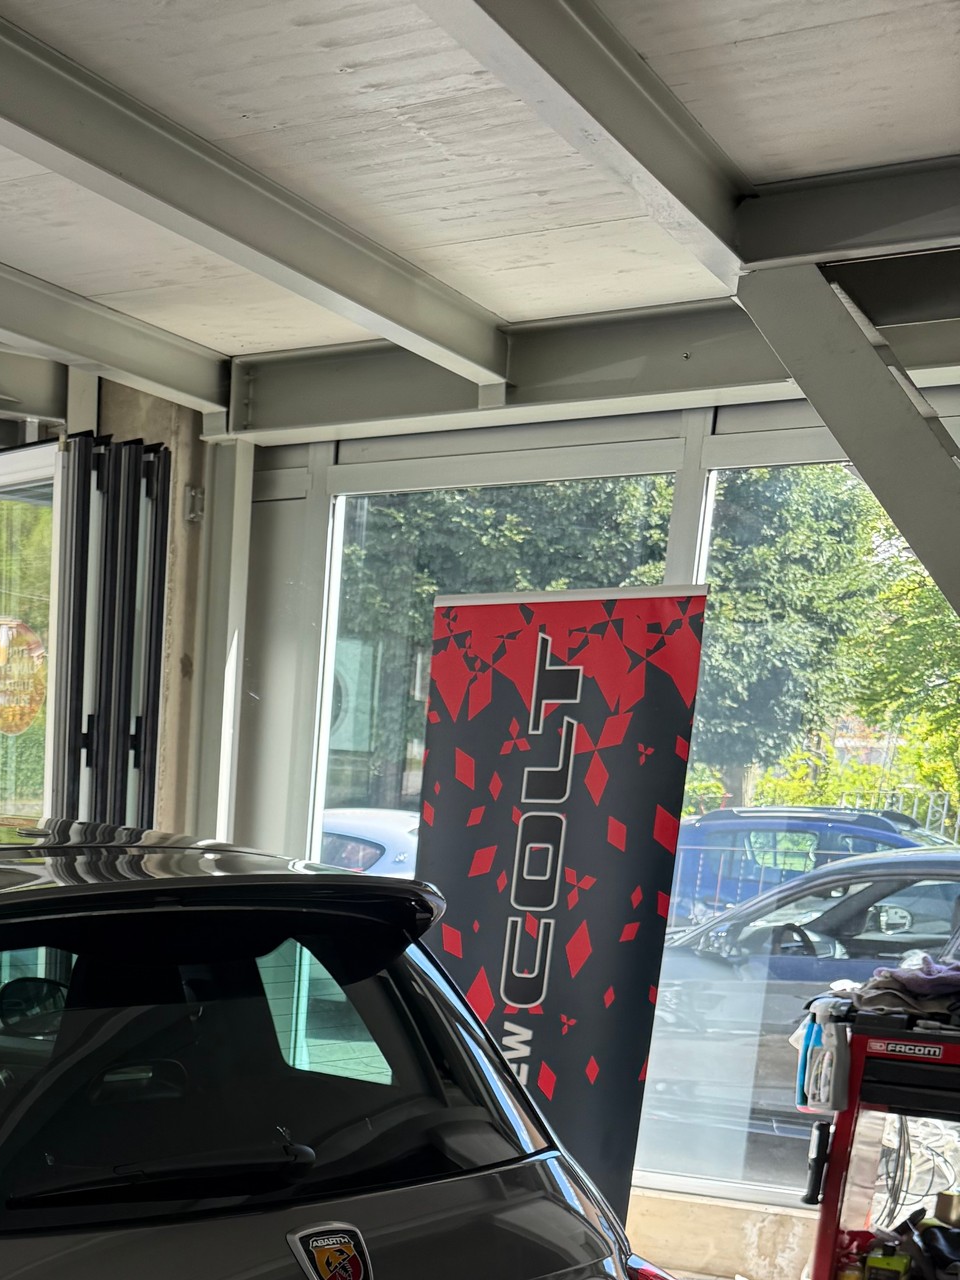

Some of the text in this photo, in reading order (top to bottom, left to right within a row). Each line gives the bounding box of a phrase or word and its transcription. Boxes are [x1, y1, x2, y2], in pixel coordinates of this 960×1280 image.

[499, 632, 584, 1008] COLT
[887, 1043, 941, 1057] FACOM
[312, 1237, 349, 1248] ABARTH
